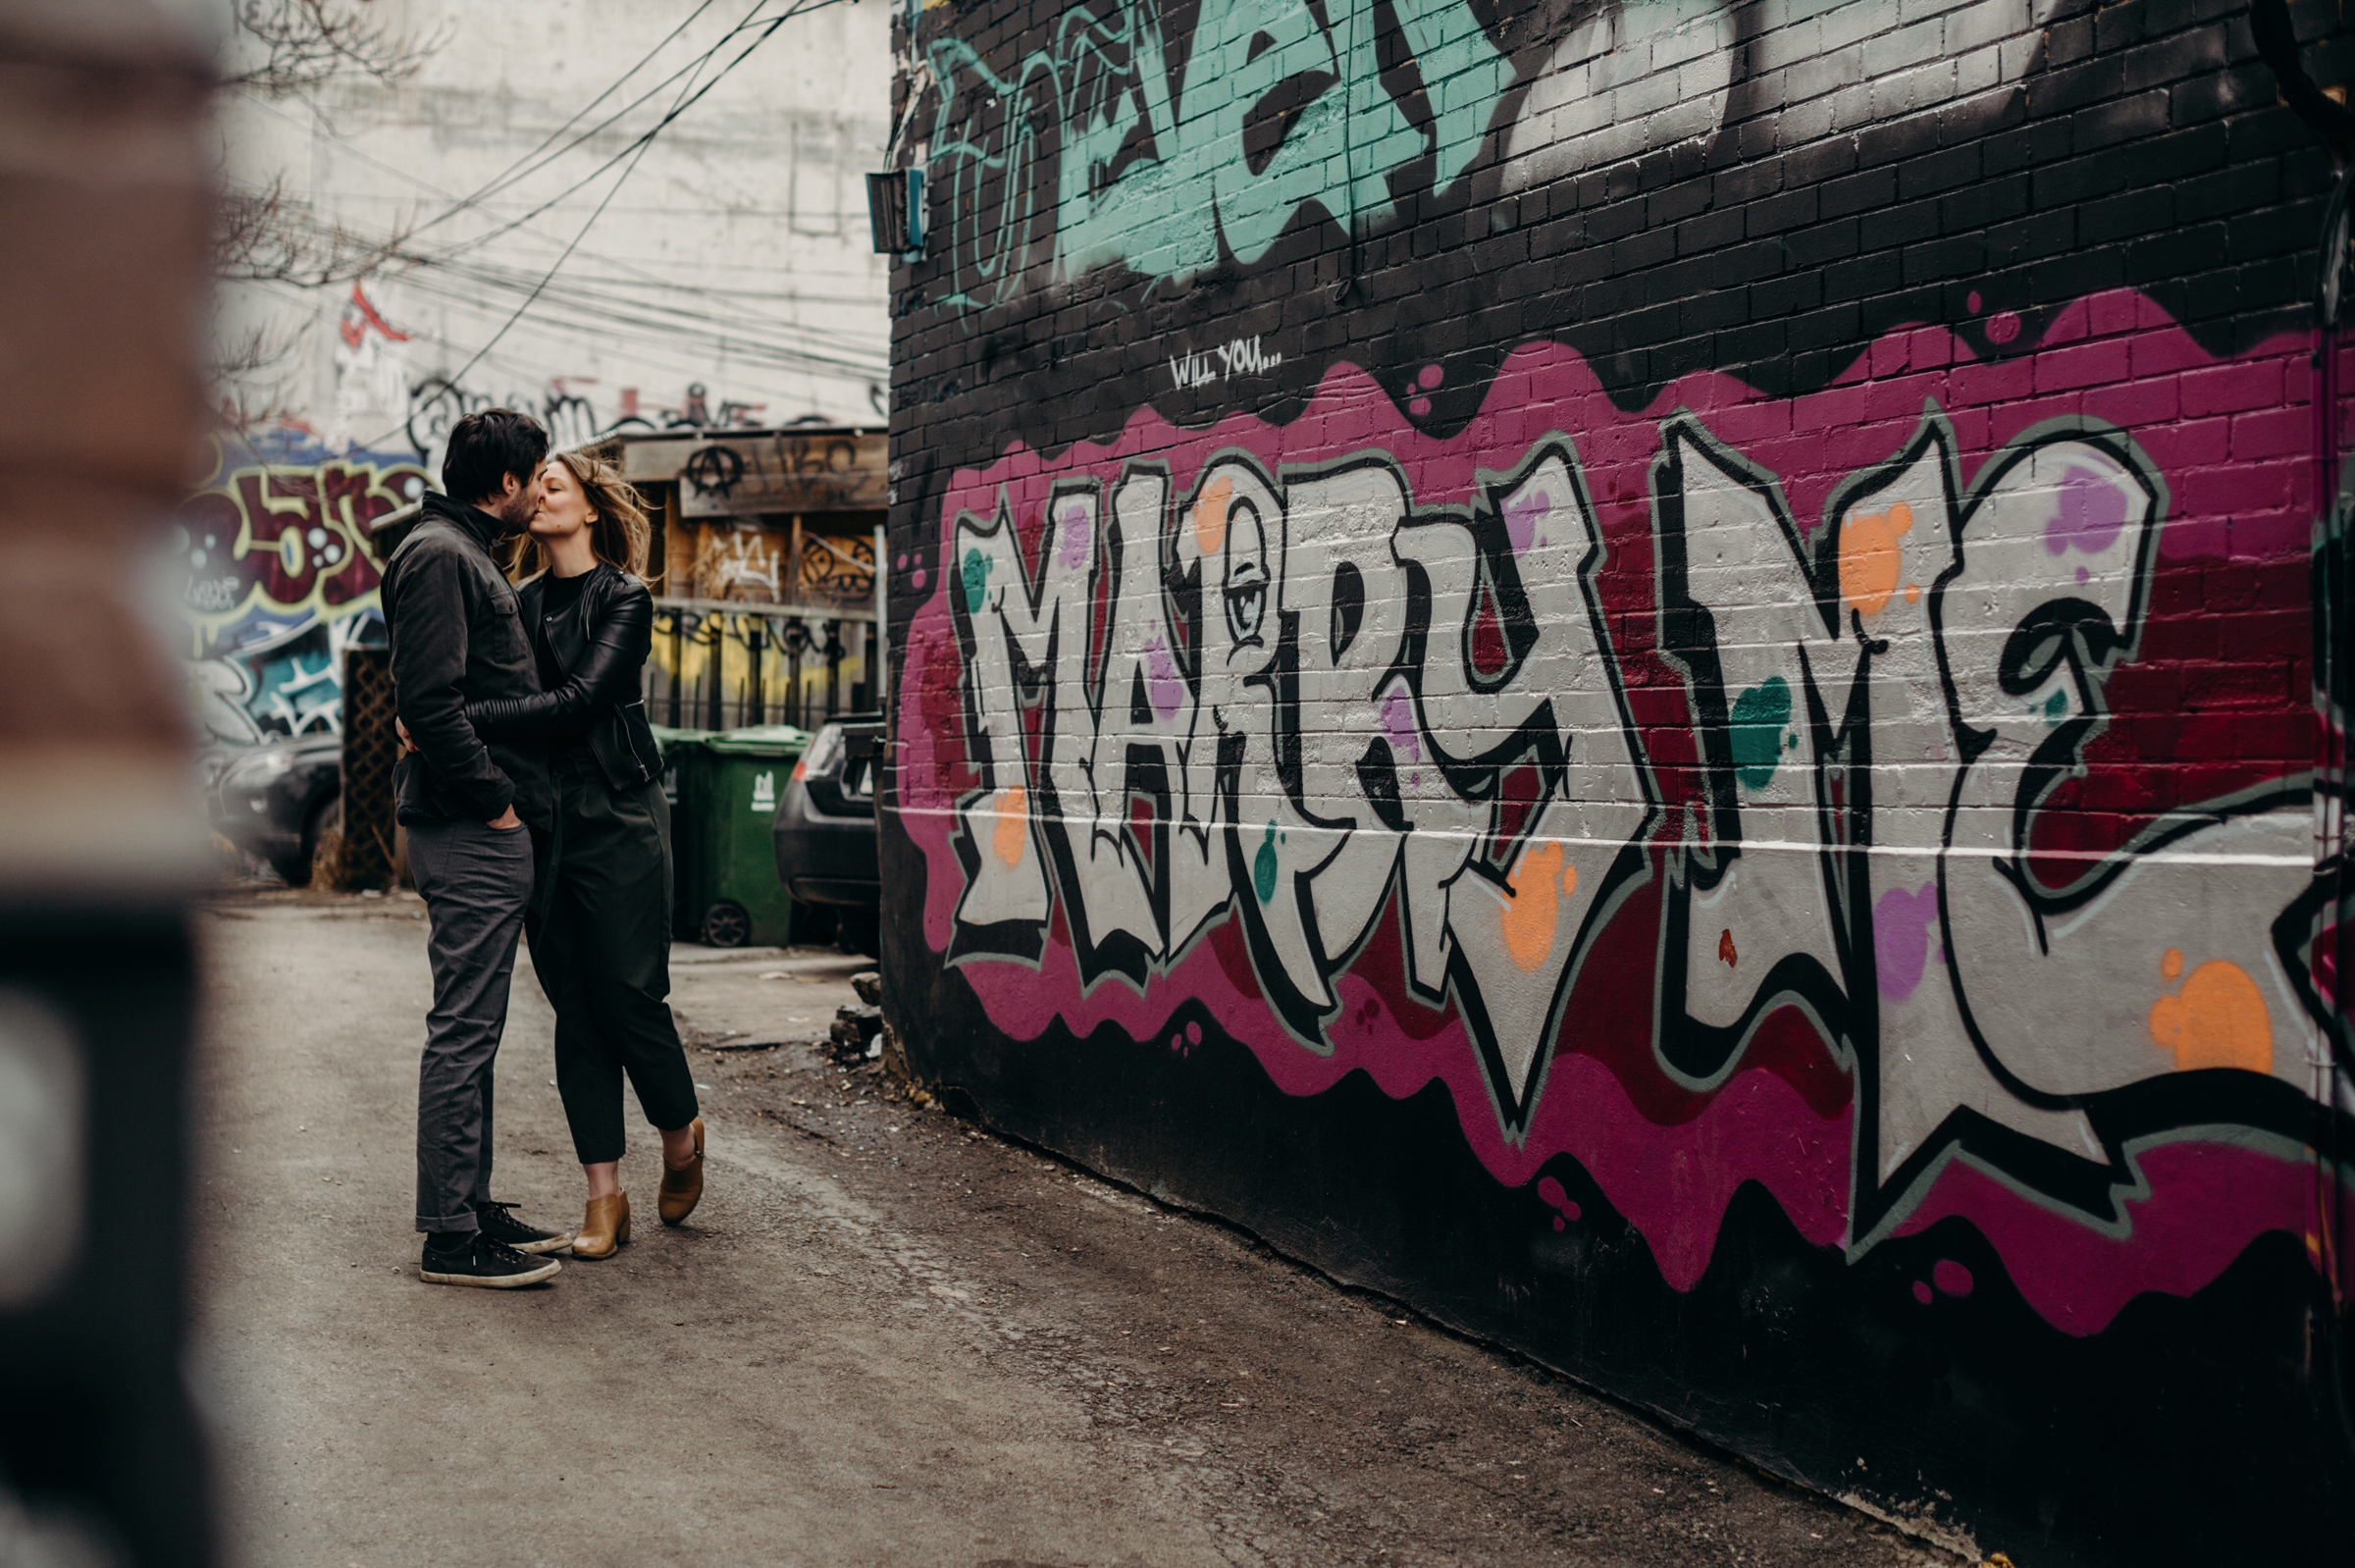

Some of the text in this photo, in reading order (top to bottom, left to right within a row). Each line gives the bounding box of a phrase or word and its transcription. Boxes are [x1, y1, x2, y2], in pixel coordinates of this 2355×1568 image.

[1169, 346, 1217, 391] WILL
[945, 397, 2355, 1263] MARRY ME
